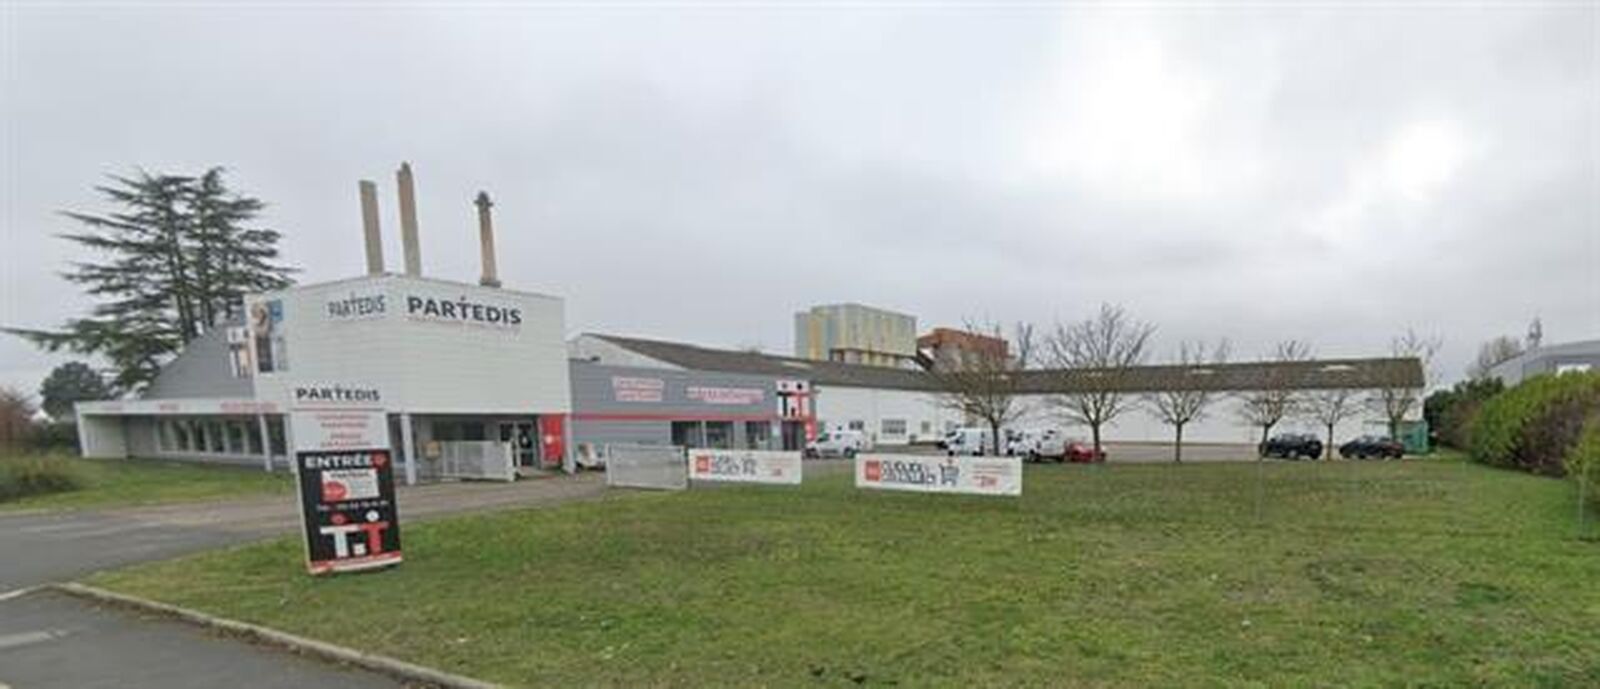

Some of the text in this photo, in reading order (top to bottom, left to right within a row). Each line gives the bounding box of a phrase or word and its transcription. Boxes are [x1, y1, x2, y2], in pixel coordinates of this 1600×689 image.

[328, 292, 386, 319] PARTEDIS
[406, 295, 522, 325] PARTEDIS
[296, 384, 381, 401] PARTEDIS
